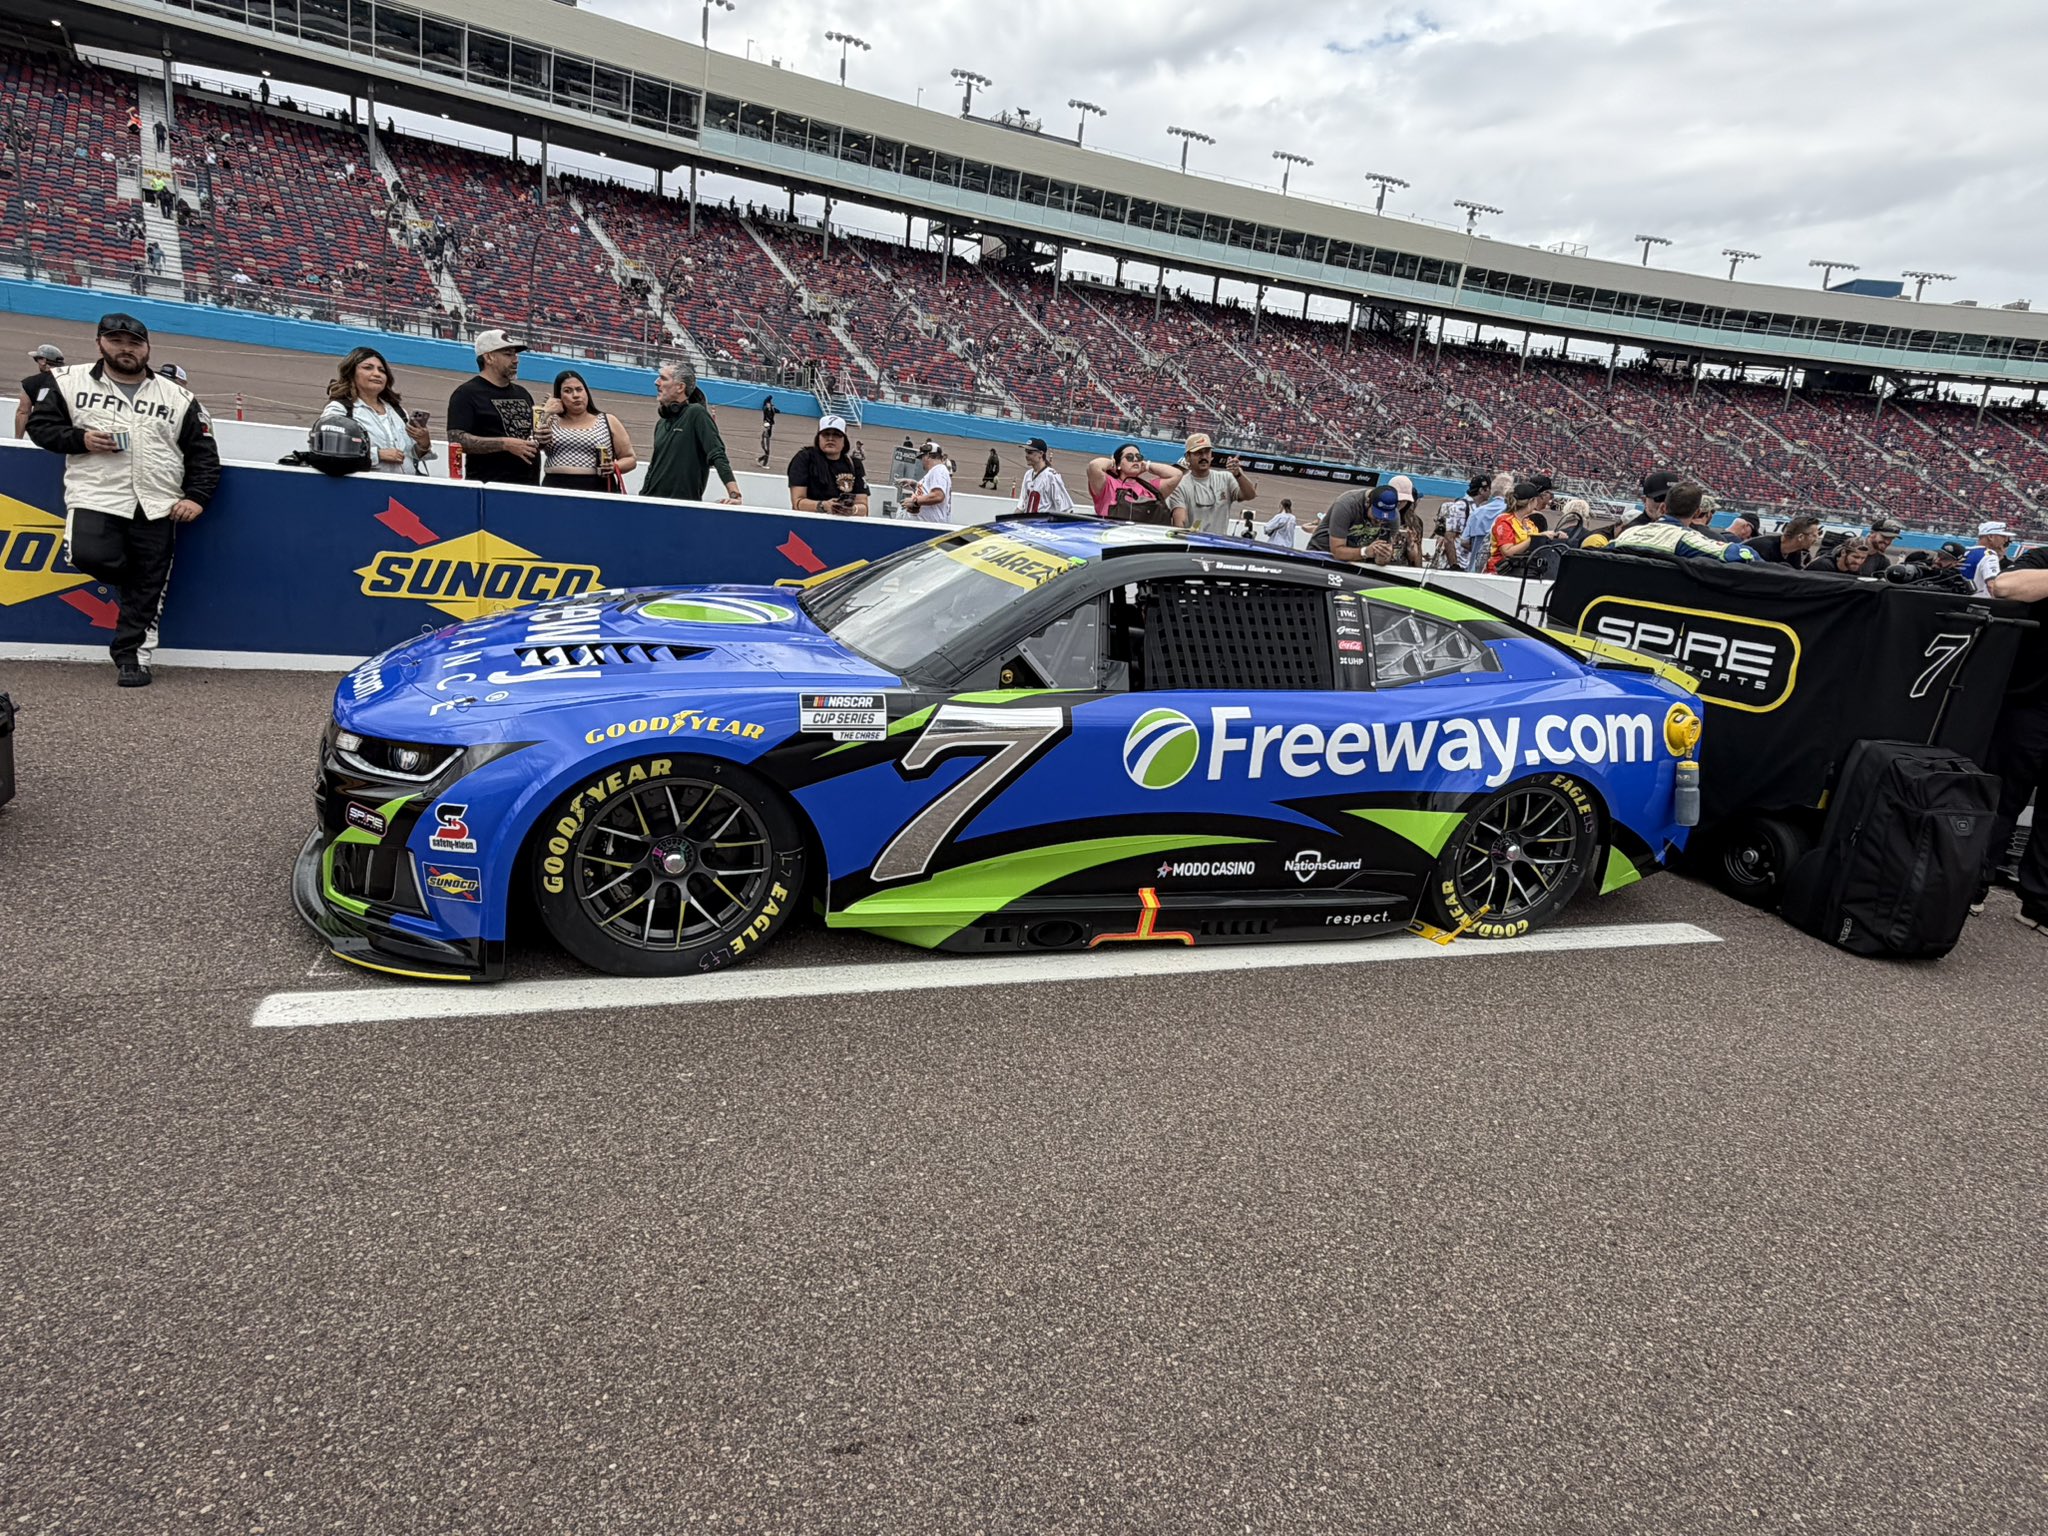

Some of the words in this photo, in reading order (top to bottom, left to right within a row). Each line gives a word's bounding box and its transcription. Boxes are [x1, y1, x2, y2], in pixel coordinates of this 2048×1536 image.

[76, 391, 176, 425] OFFICIAL
[368, 556, 594, 601] SUNOCO
[972, 545, 1055, 581] SUÁREZ
[1347, 657, 1364, 665] UHP
[1597, 616, 1777, 677] SPIRE
[1909, 633, 1971, 699] 7
[812, 713, 835, 724] CUP
[836, 713, 875, 724] SERIES
[827, 696, 874, 708] NASCAR
[584, 710, 766, 745] GOODYEAR
[840, 731, 854, 740] THE
[854, 731, 881, 740] CHASE
[1207, 706, 1654, 788] Freeway.com
[870, 704, 1064, 882] 7
[1550, 774, 1592, 815] EAGLE
[349, 806, 384, 829] SPIRE
[543, 758, 672, 894] GOODYEAR
[1172, 862, 1210, 877] MODO
[1211, 861, 1256, 876] CASINO
[1284, 858, 1362, 872] NationsGuard
[429, 877, 477, 891] SUNOCO
[730, 881, 788, 955] EAGLE
[1325, 910, 1391, 926] respect.
